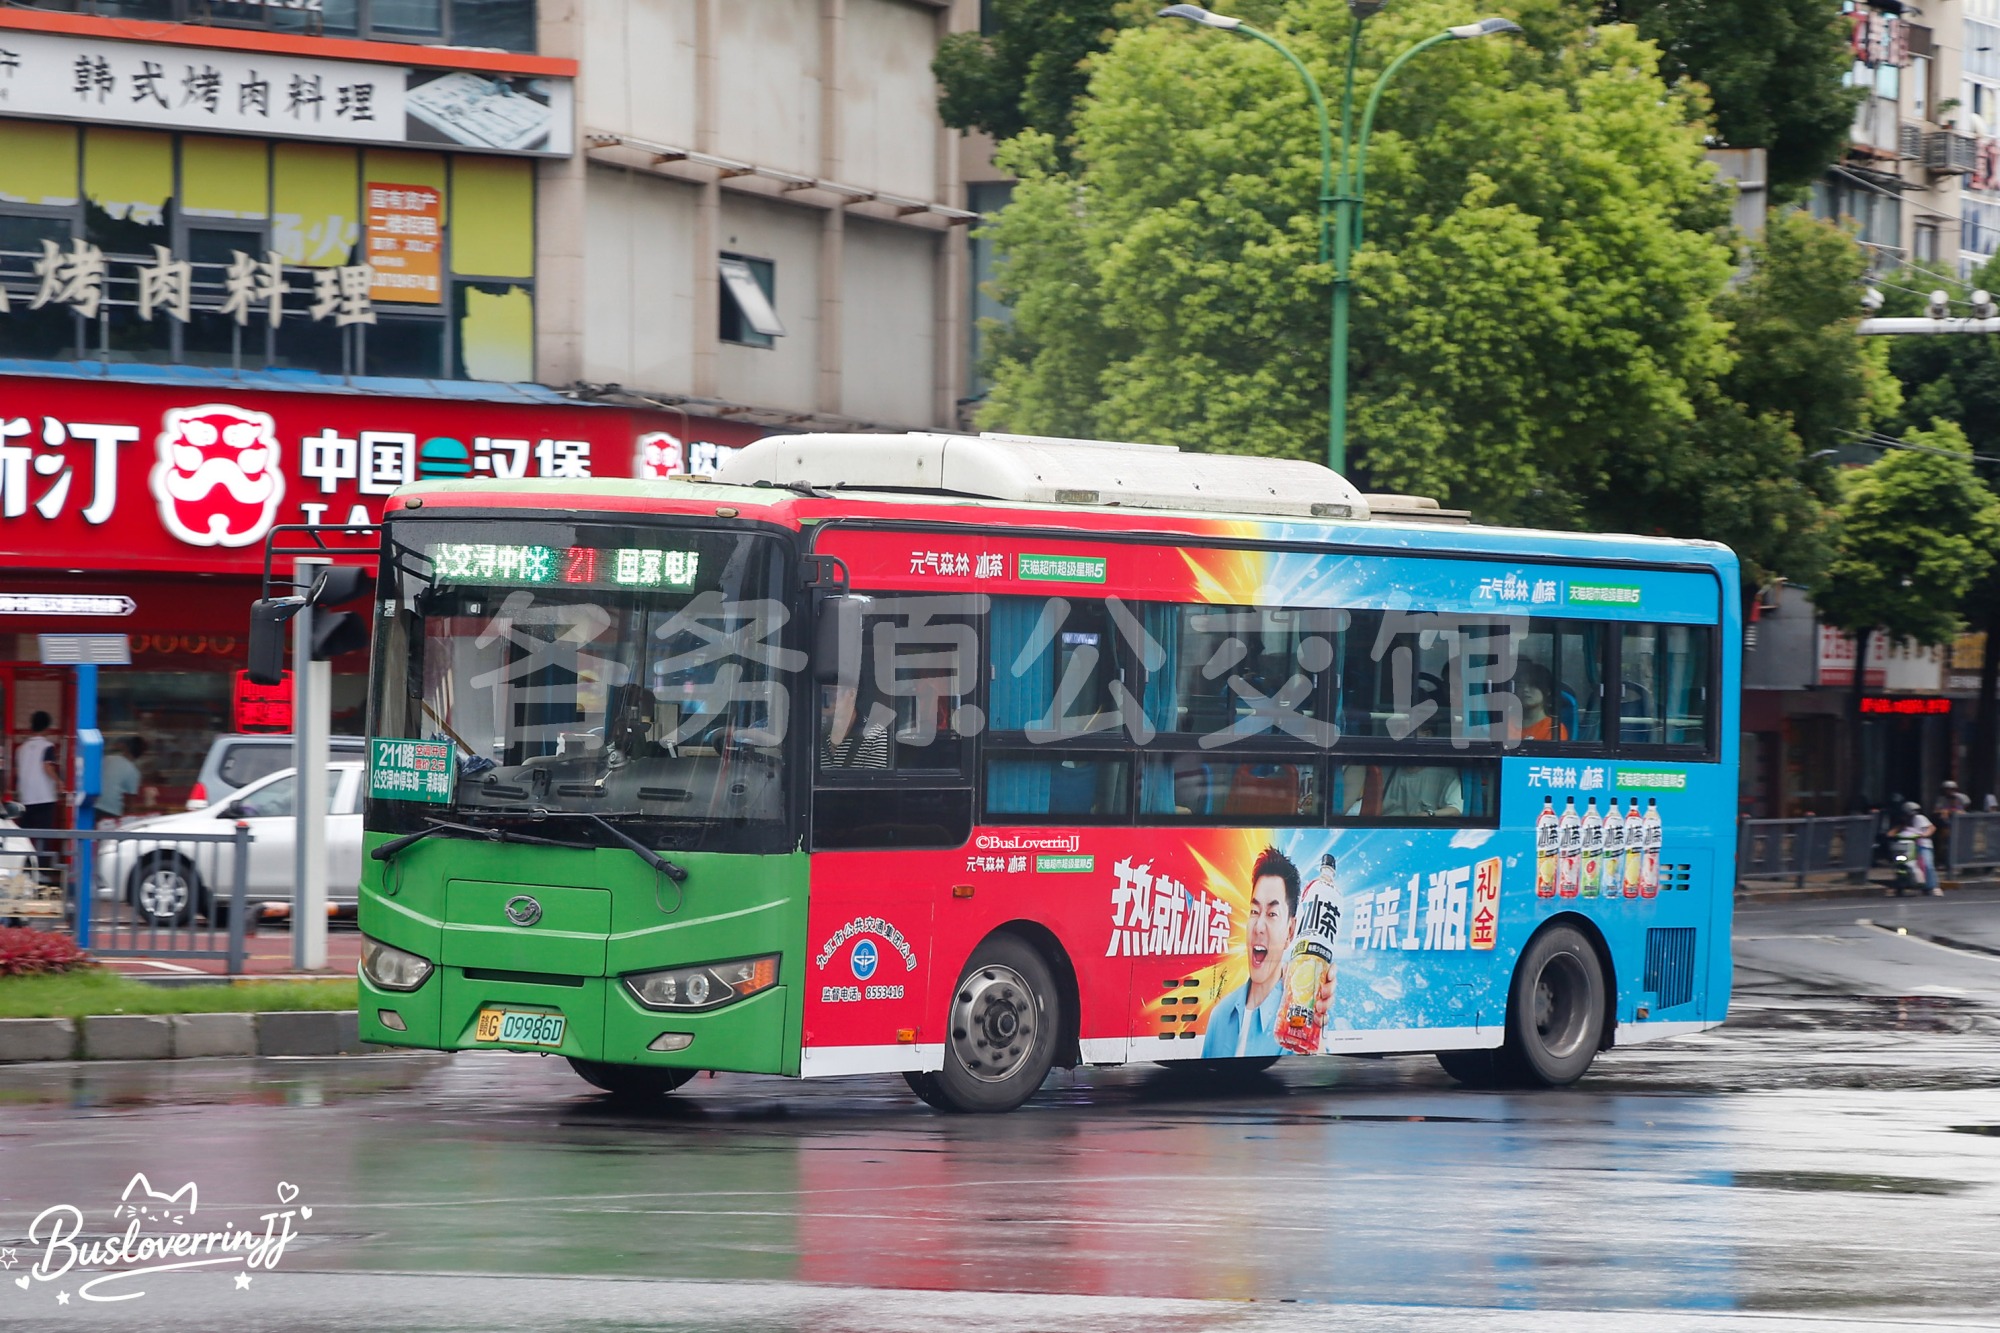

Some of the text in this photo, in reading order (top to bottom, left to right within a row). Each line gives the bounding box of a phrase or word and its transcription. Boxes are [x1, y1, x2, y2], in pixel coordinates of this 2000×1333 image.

[73, 54, 378, 122] 韩式烤肉料理
[0, 238, 377, 326] 烤肉料理
[566, 547, 595, 583] 21
[910, 550, 970, 577] 元气森林
[378, 743, 415, 769] 211路
[1528, 766, 1577, 789] 元气森林
[966, 856, 1005, 872] 元气森林
[816, 916, 917, 971] 九江市公共交通集团公司
[865, 985, 905, 1000] 8553416
